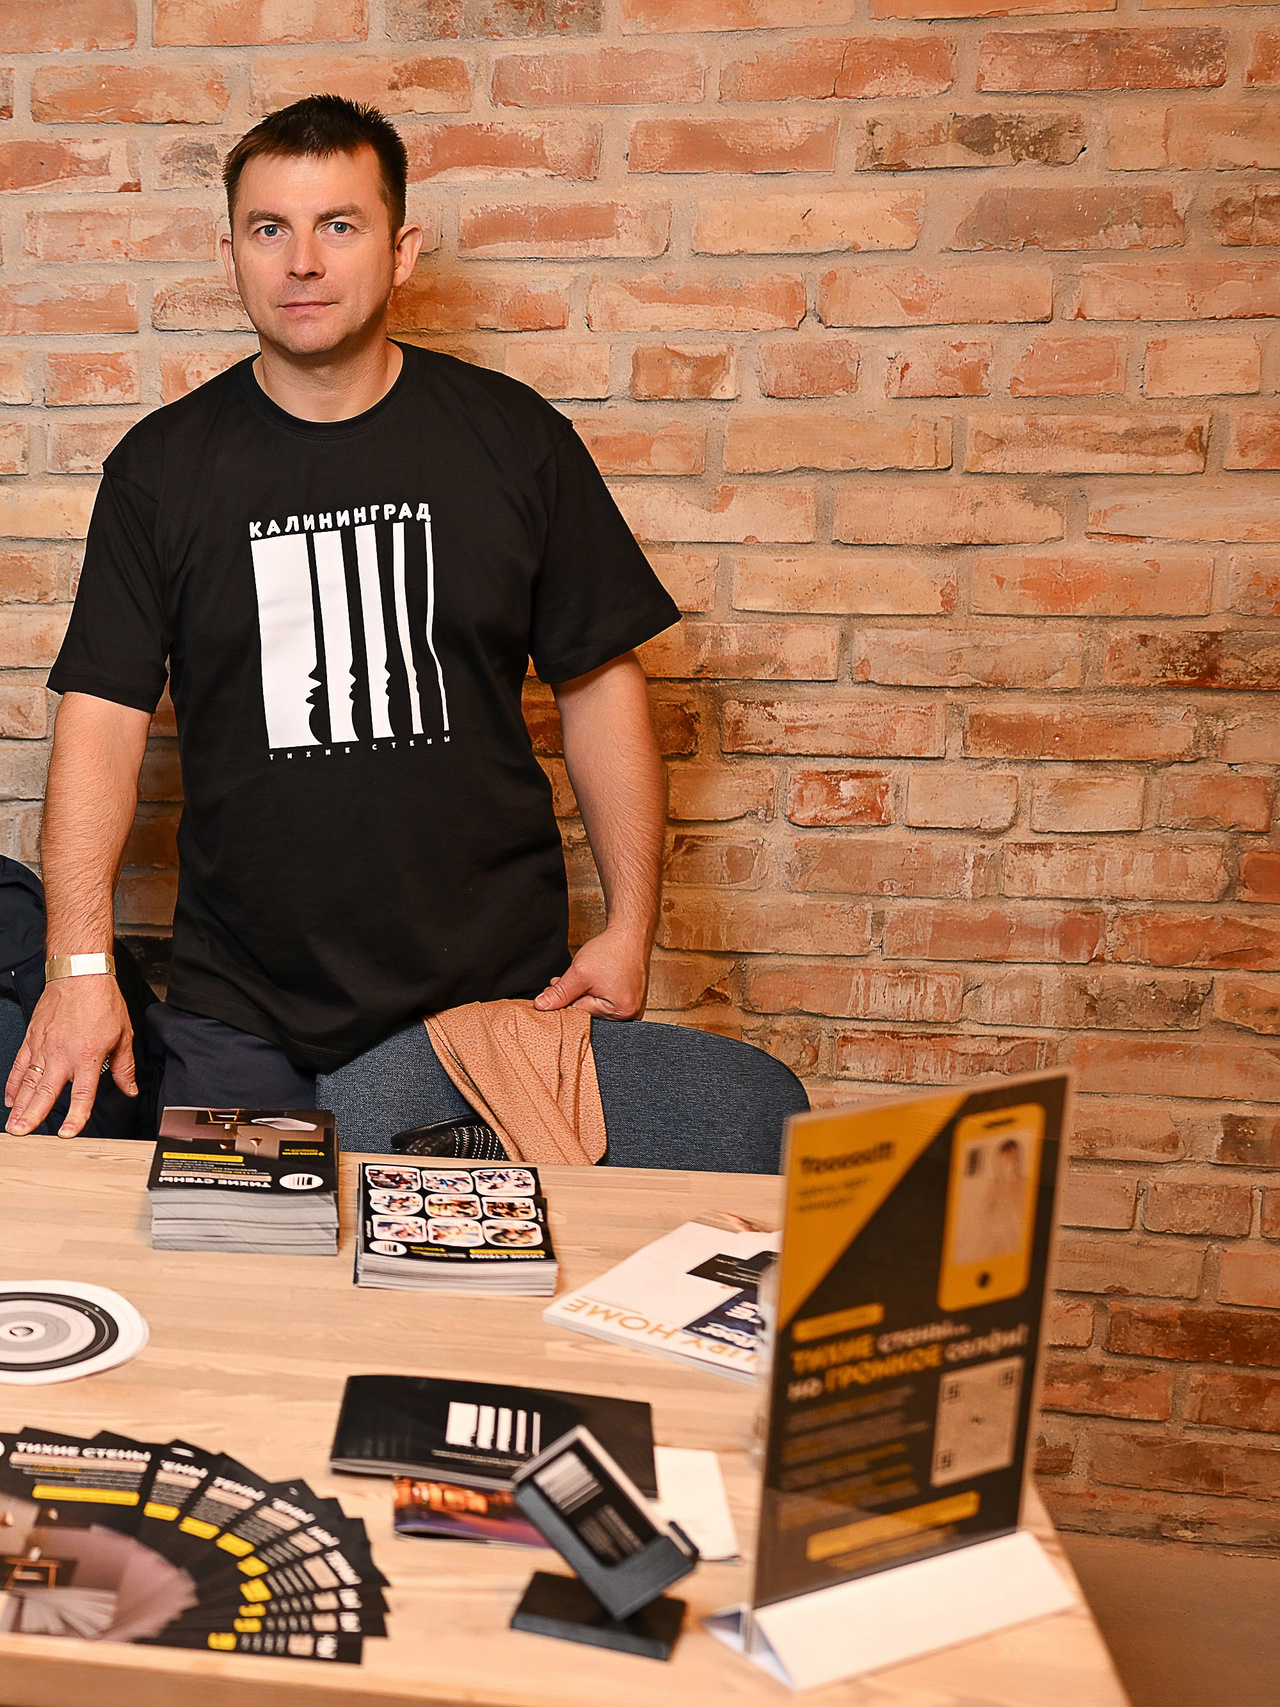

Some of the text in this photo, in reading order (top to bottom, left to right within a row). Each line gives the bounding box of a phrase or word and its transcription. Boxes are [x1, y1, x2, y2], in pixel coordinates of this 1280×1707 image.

[249, 502, 432, 538] КАЛИНИНГРАД
[269, 735, 451, 760] ТИХИЕ СТЕНЫ
[563, 1298, 679, 1341] HOME
[15, 1441, 151, 1462] ТИХИЕ СТЕНЫ
[160, 1460, 209, 1479] ЕНЫ
[212, 1476, 267, 1501] ТЕНЫ
